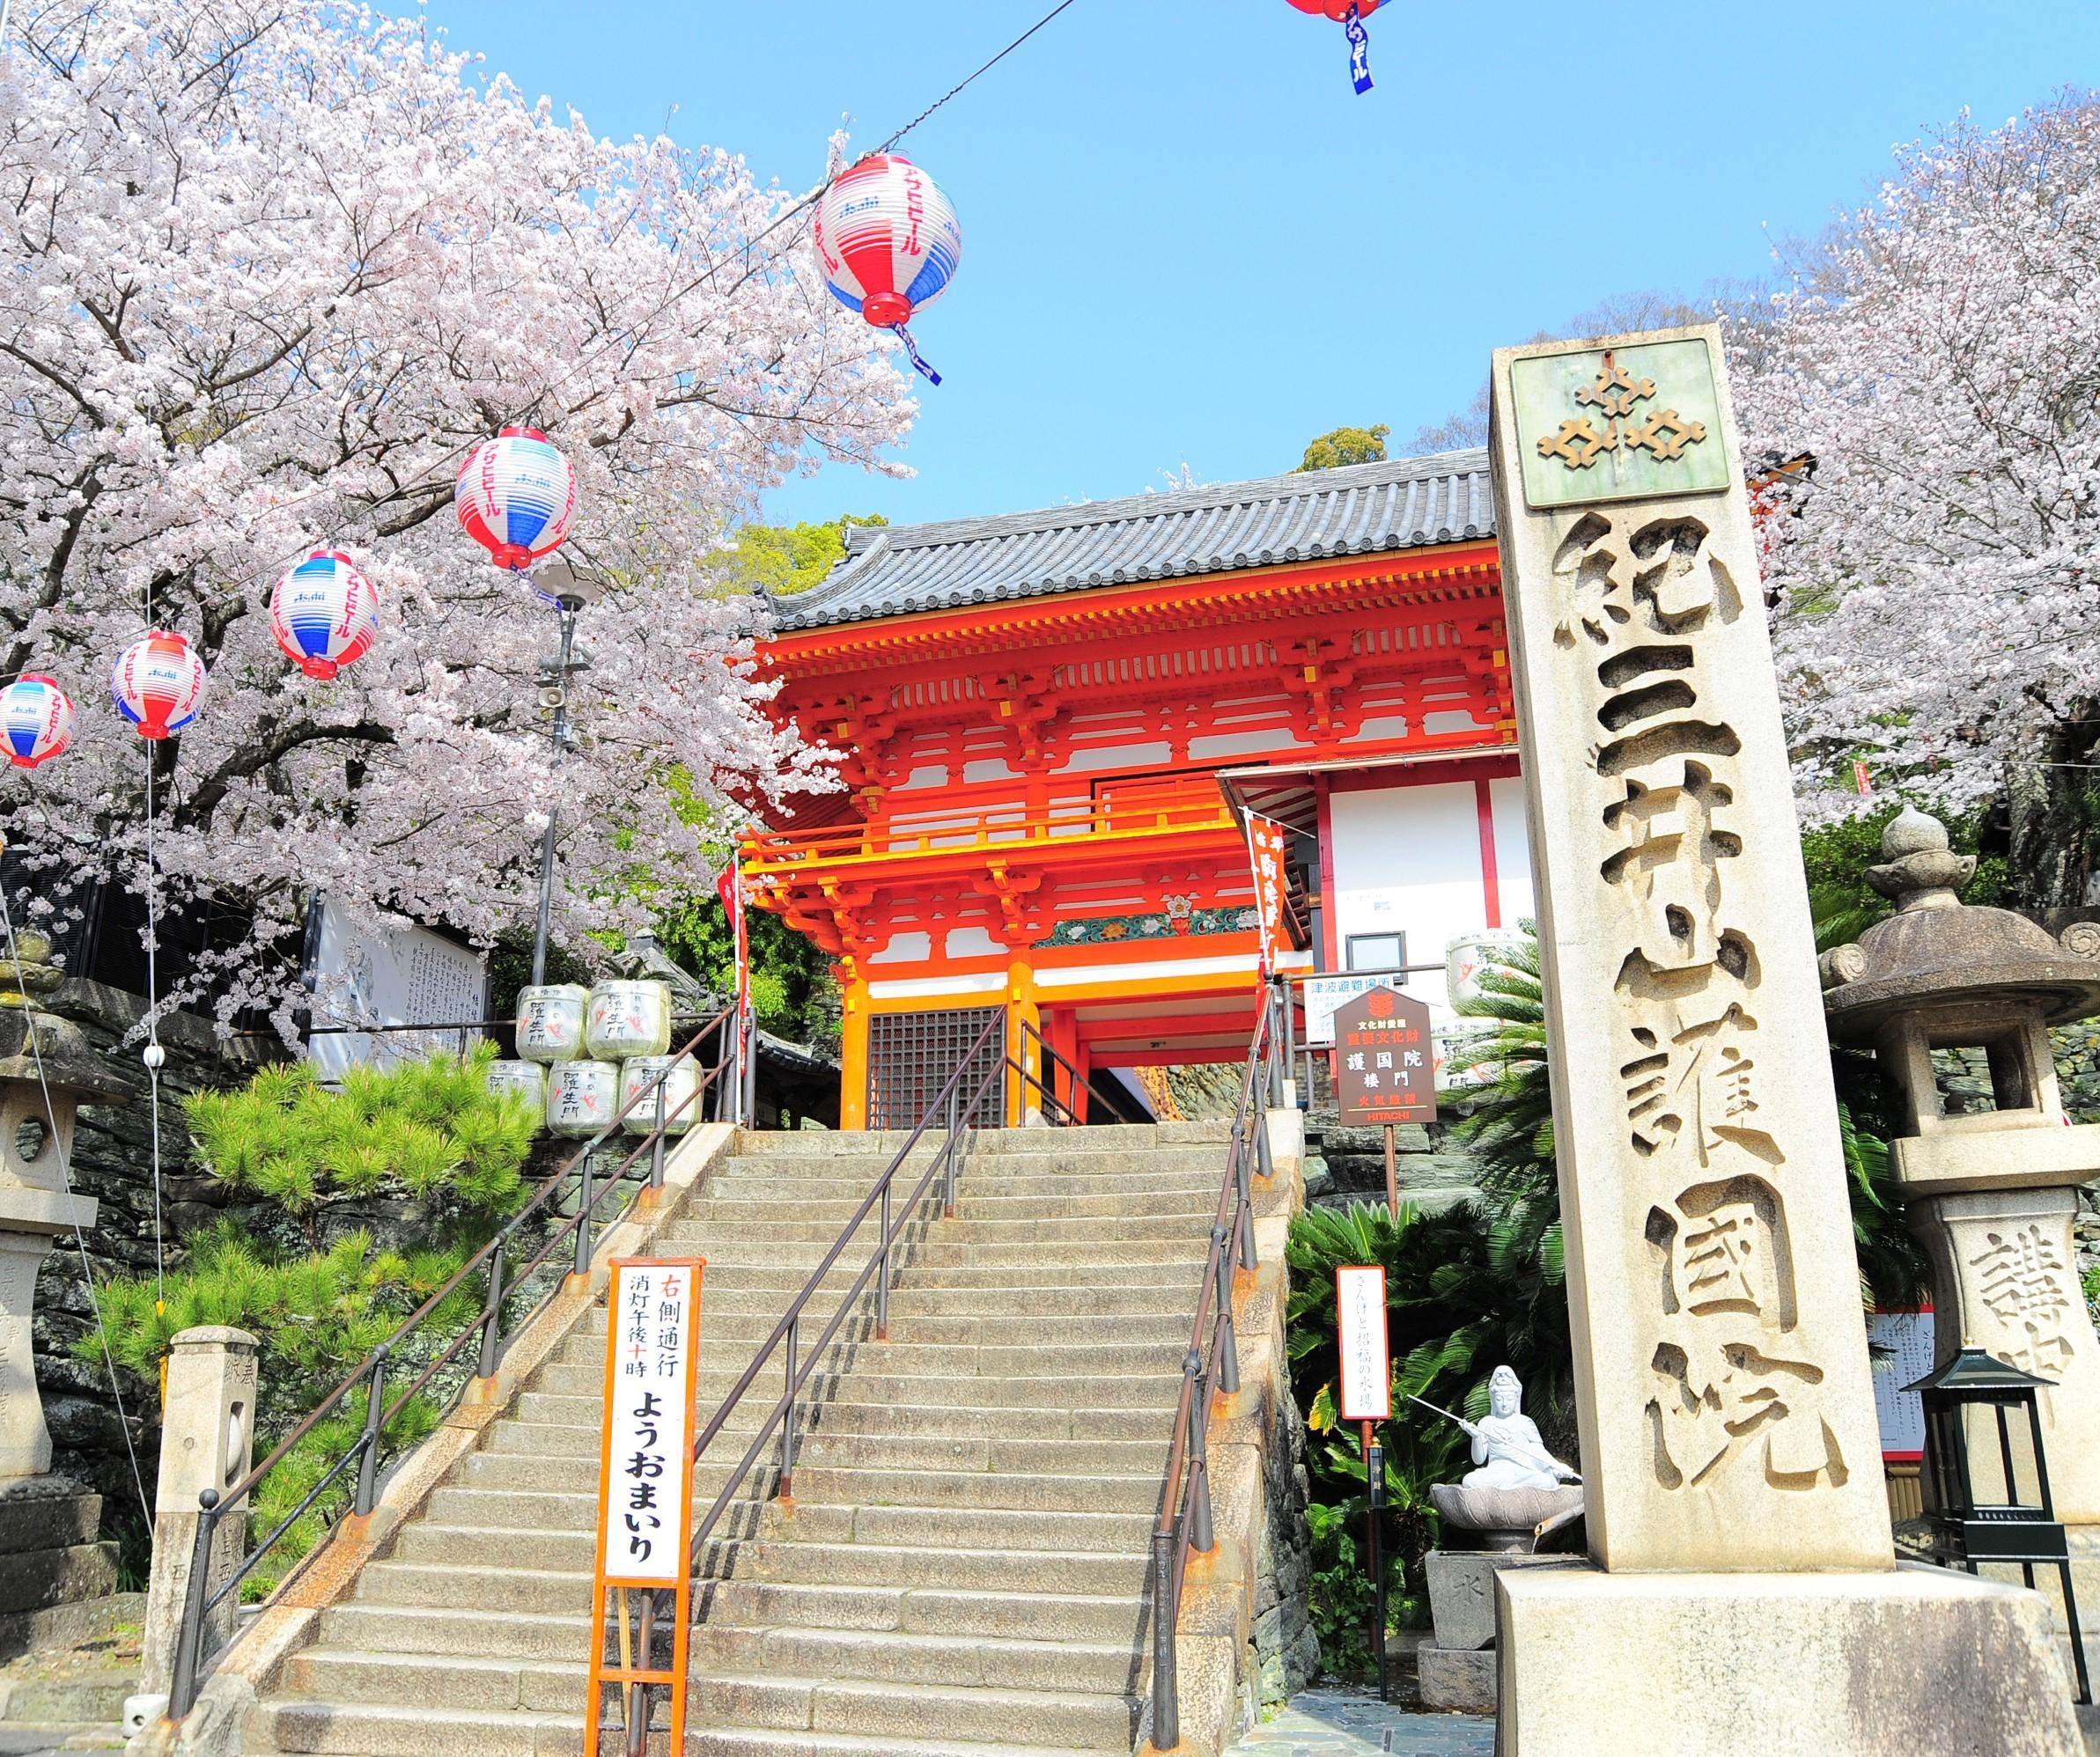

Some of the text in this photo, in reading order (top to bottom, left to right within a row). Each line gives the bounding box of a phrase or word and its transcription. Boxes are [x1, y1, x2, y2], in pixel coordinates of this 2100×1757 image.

[839, 196, 879, 218] Asahi
[900, 166, 923, 256] アサヒビール
[482, 443, 500, 518] アサヒビール
[294, 592, 325, 604] Asahi
[335, 571, 360, 638] アサヒビール
[148, 669, 177, 680] Asahi
[41, 693, 62, 744] アサヒビール
[1346, 1049, 1423, 1071] 護国院
[560, 1071, 580, 1119] 羅生門
[1367, 1111, 1411, 1121] HITACHI
[625, 1275, 651, 1378] 消灯午後十時
[658, 1273, 682, 1378] 右側通行
[624, 1391, 666, 1564] ようおまいり
[1454, 1573, 1485, 1605] 水
